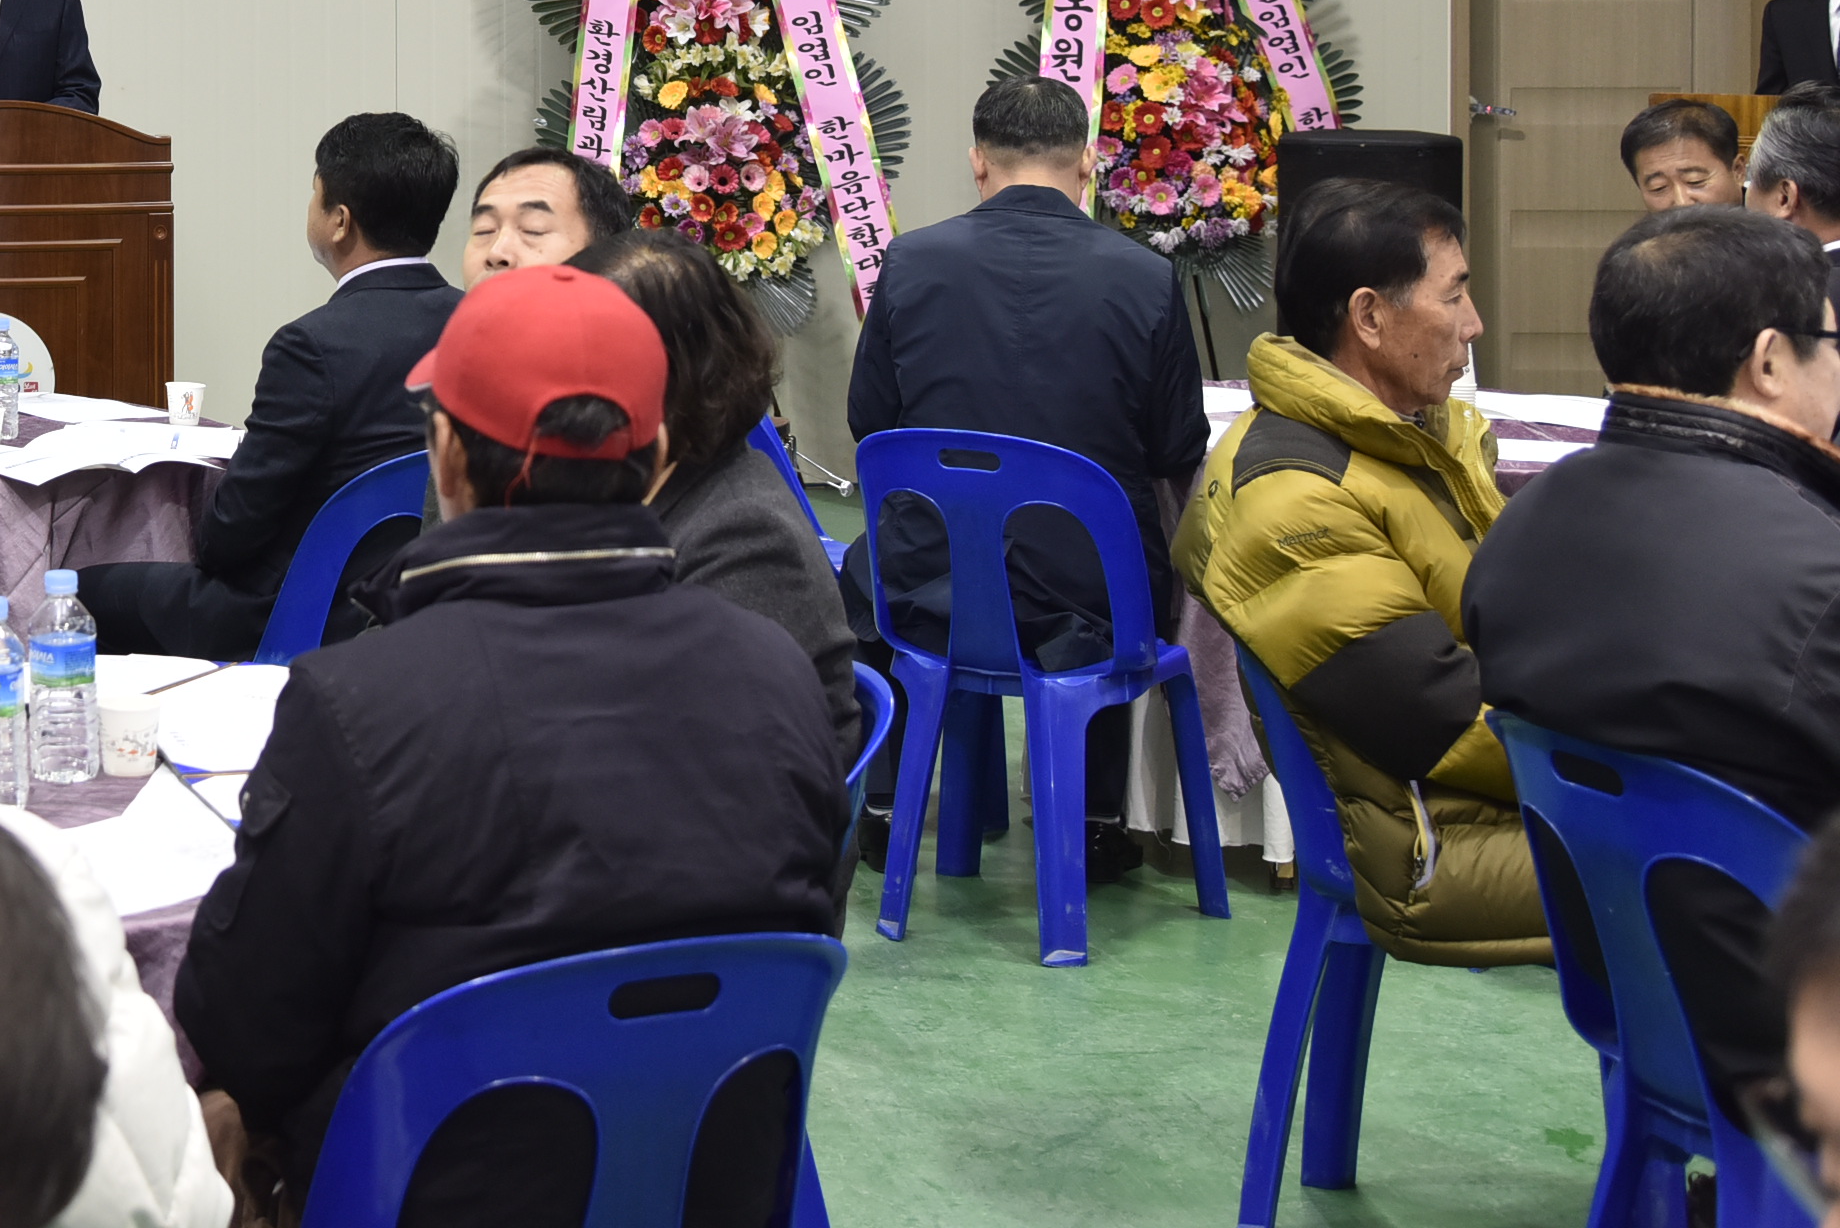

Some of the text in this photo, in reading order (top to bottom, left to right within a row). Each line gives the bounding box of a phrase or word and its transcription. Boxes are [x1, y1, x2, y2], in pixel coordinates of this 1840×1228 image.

[791, 11, 838, 87] 임업인
[577, 18, 621, 159] 환경산림과
[1276, 527, 1330, 549] Marmot
